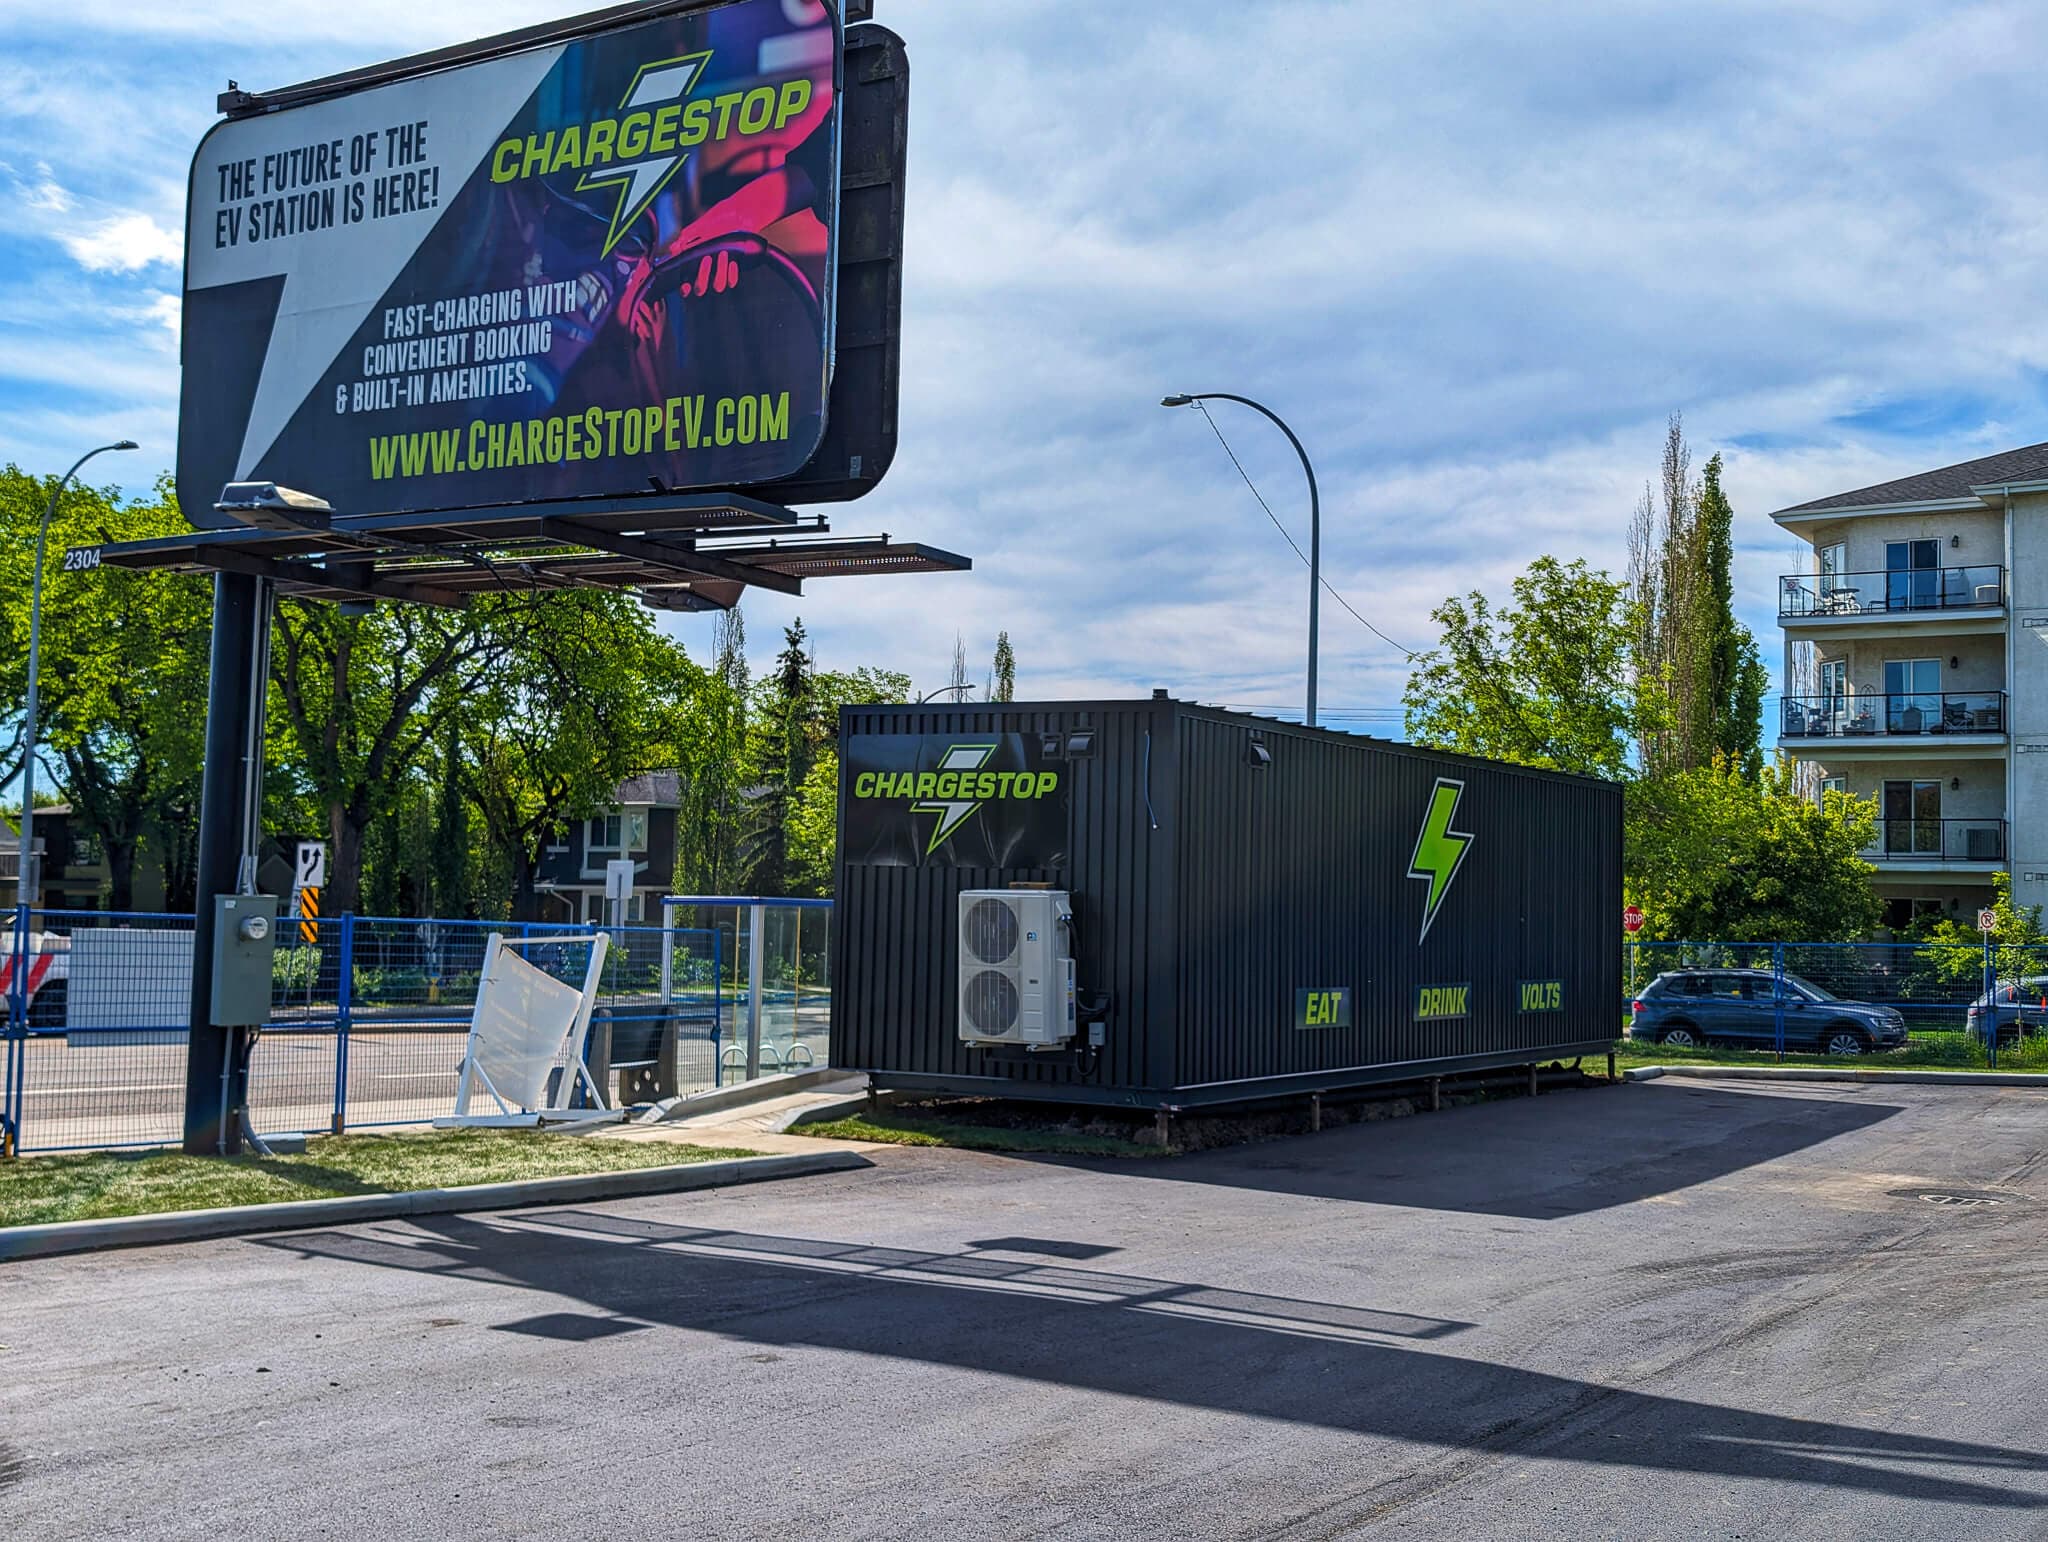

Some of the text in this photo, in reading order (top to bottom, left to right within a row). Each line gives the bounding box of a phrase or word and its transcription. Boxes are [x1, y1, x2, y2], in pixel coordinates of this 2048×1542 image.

[491, 79, 811, 183] CHARGESTOP
[218, 120, 428, 203] THE FUTURE OF THE
[216, 166, 439, 249] EV STATION IS HERE!
[384, 280, 577, 339] FAST-CHARGING WITH
[363, 321, 552, 377] CONVENIENT BOOKING
[335, 361, 532, 415] & BUILT-IN AMENITIES.
[64, 549, 100, 570] 2304
[855, 772, 1058, 799] CHARGESTOP
[1624, 913, 1643, 925] STOP
[1305, 992, 1342, 1025] EAT
[1418, 986, 1468, 1017] DRINK
[1521, 982, 1561, 1011] VOLTS
